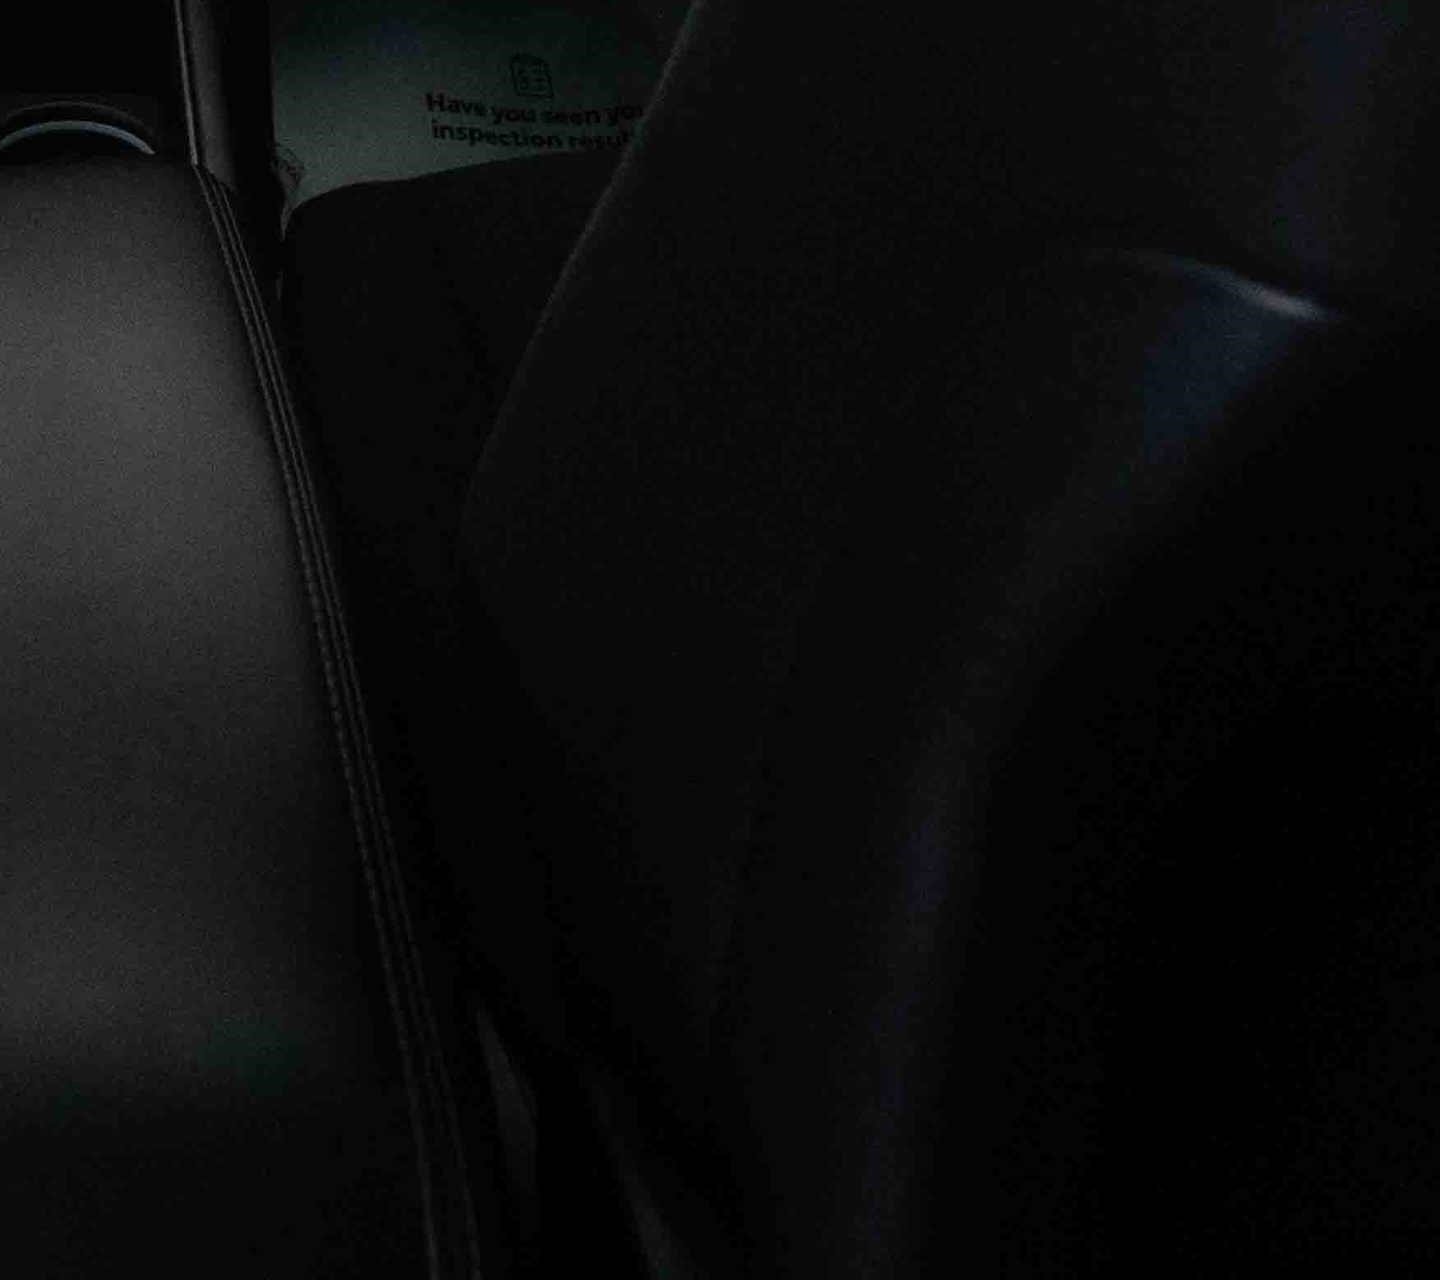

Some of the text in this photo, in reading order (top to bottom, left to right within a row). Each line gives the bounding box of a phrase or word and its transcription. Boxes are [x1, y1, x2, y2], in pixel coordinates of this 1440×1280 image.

[425, 93, 486, 116] Have
[491, 107, 536, 124] you
[543, 107, 601, 125] seen
[431, 120, 630, 150] inspection resul
